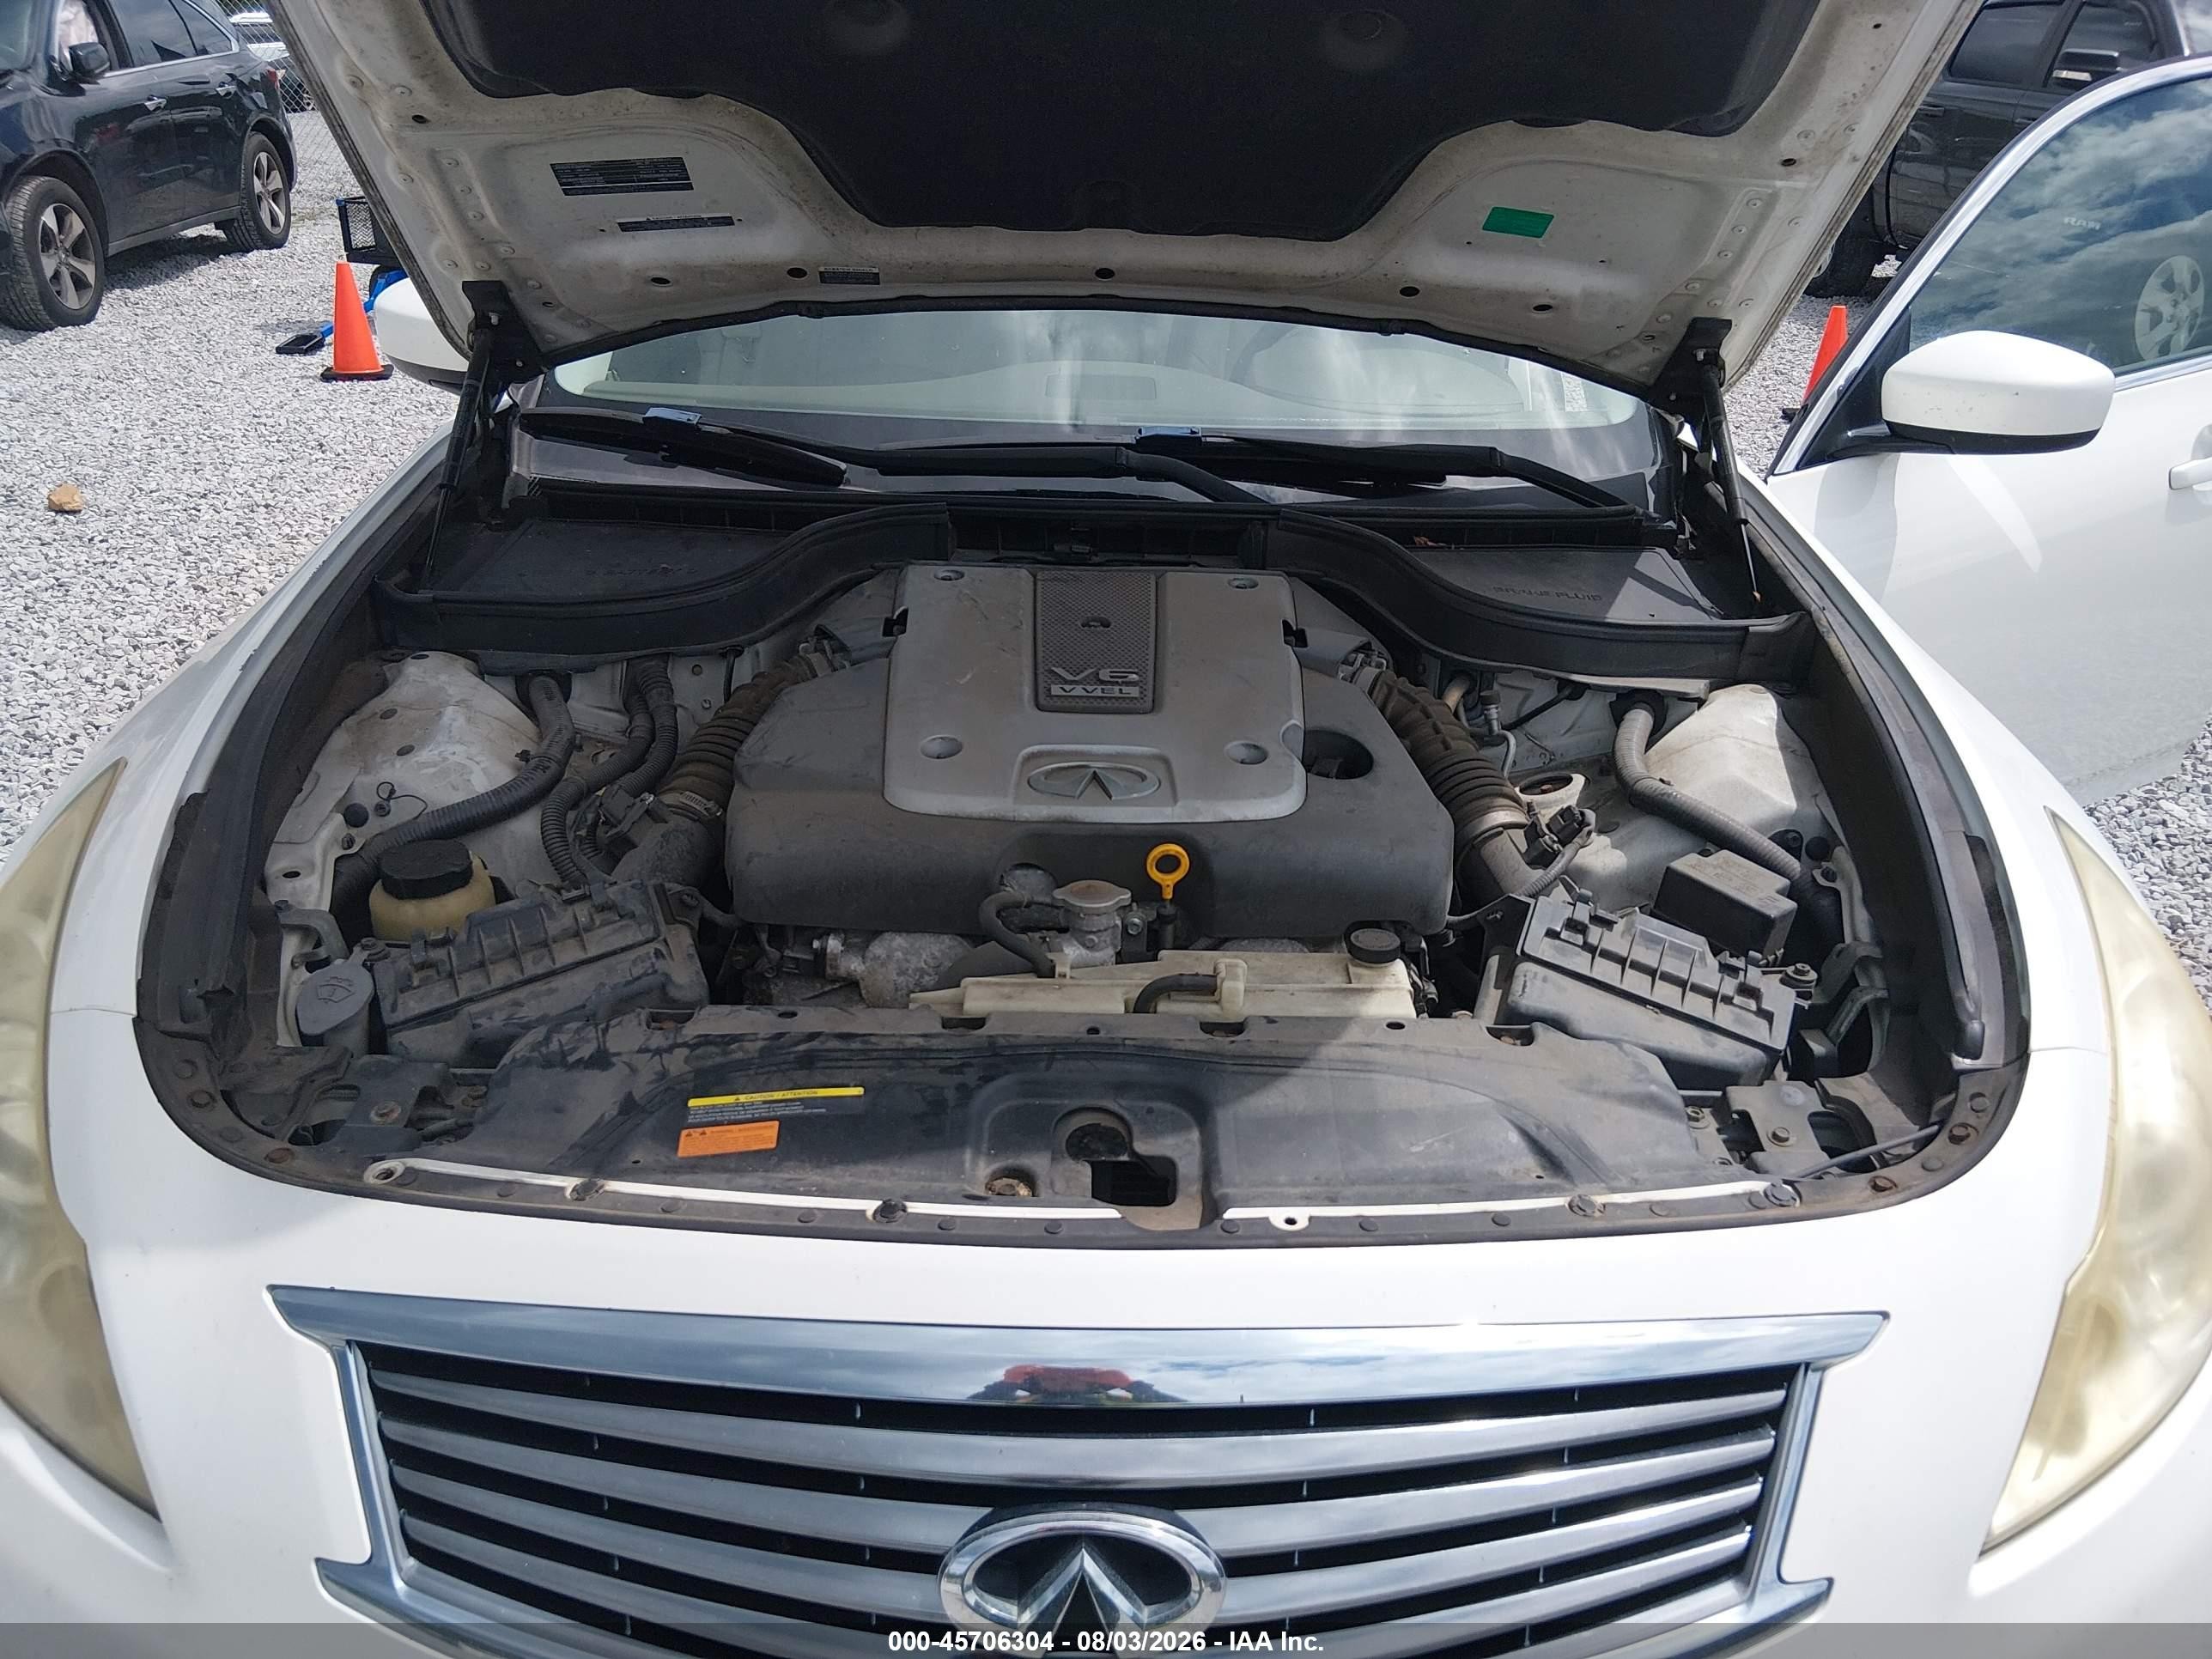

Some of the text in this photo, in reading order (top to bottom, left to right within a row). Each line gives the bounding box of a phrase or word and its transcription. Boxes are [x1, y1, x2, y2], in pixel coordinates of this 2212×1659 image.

[1555, 591, 1602, 601] FLUID
[1051, 666, 1139, 684] V6
[1059, 686, 1132, 696] VVEL
